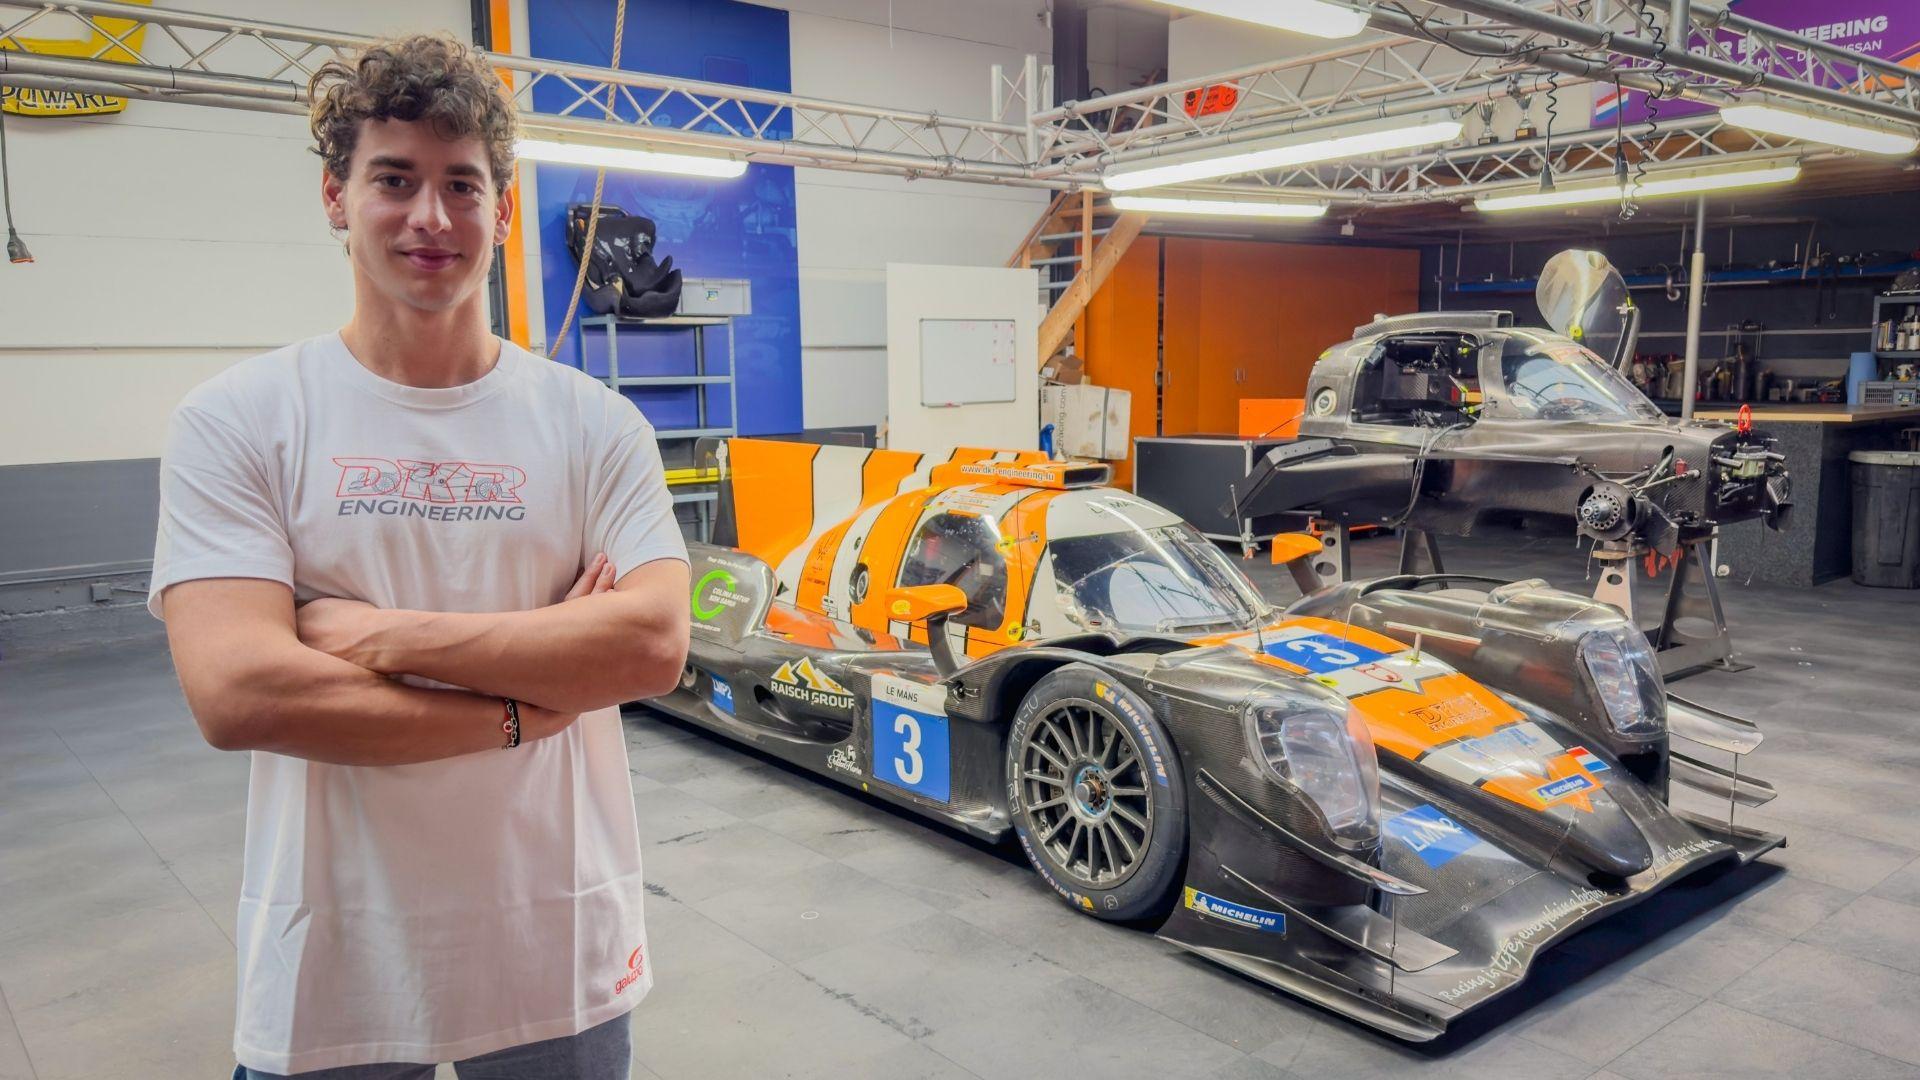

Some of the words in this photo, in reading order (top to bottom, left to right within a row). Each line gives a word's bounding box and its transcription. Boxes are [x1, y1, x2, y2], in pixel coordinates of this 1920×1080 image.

[333, 458, 526, 503] DKR
[338, 499, 525, 522] ENGINEERING
[771, 681, 809, 701] RAISCH
[886, 686, 895, 696] LE
[896, 688, 918, 703] MANS
[894, 713, 924, 785] 3
[1402, 817, 1463, 853] LM2
[1211, 902, 1276, 926] MICHELIN
